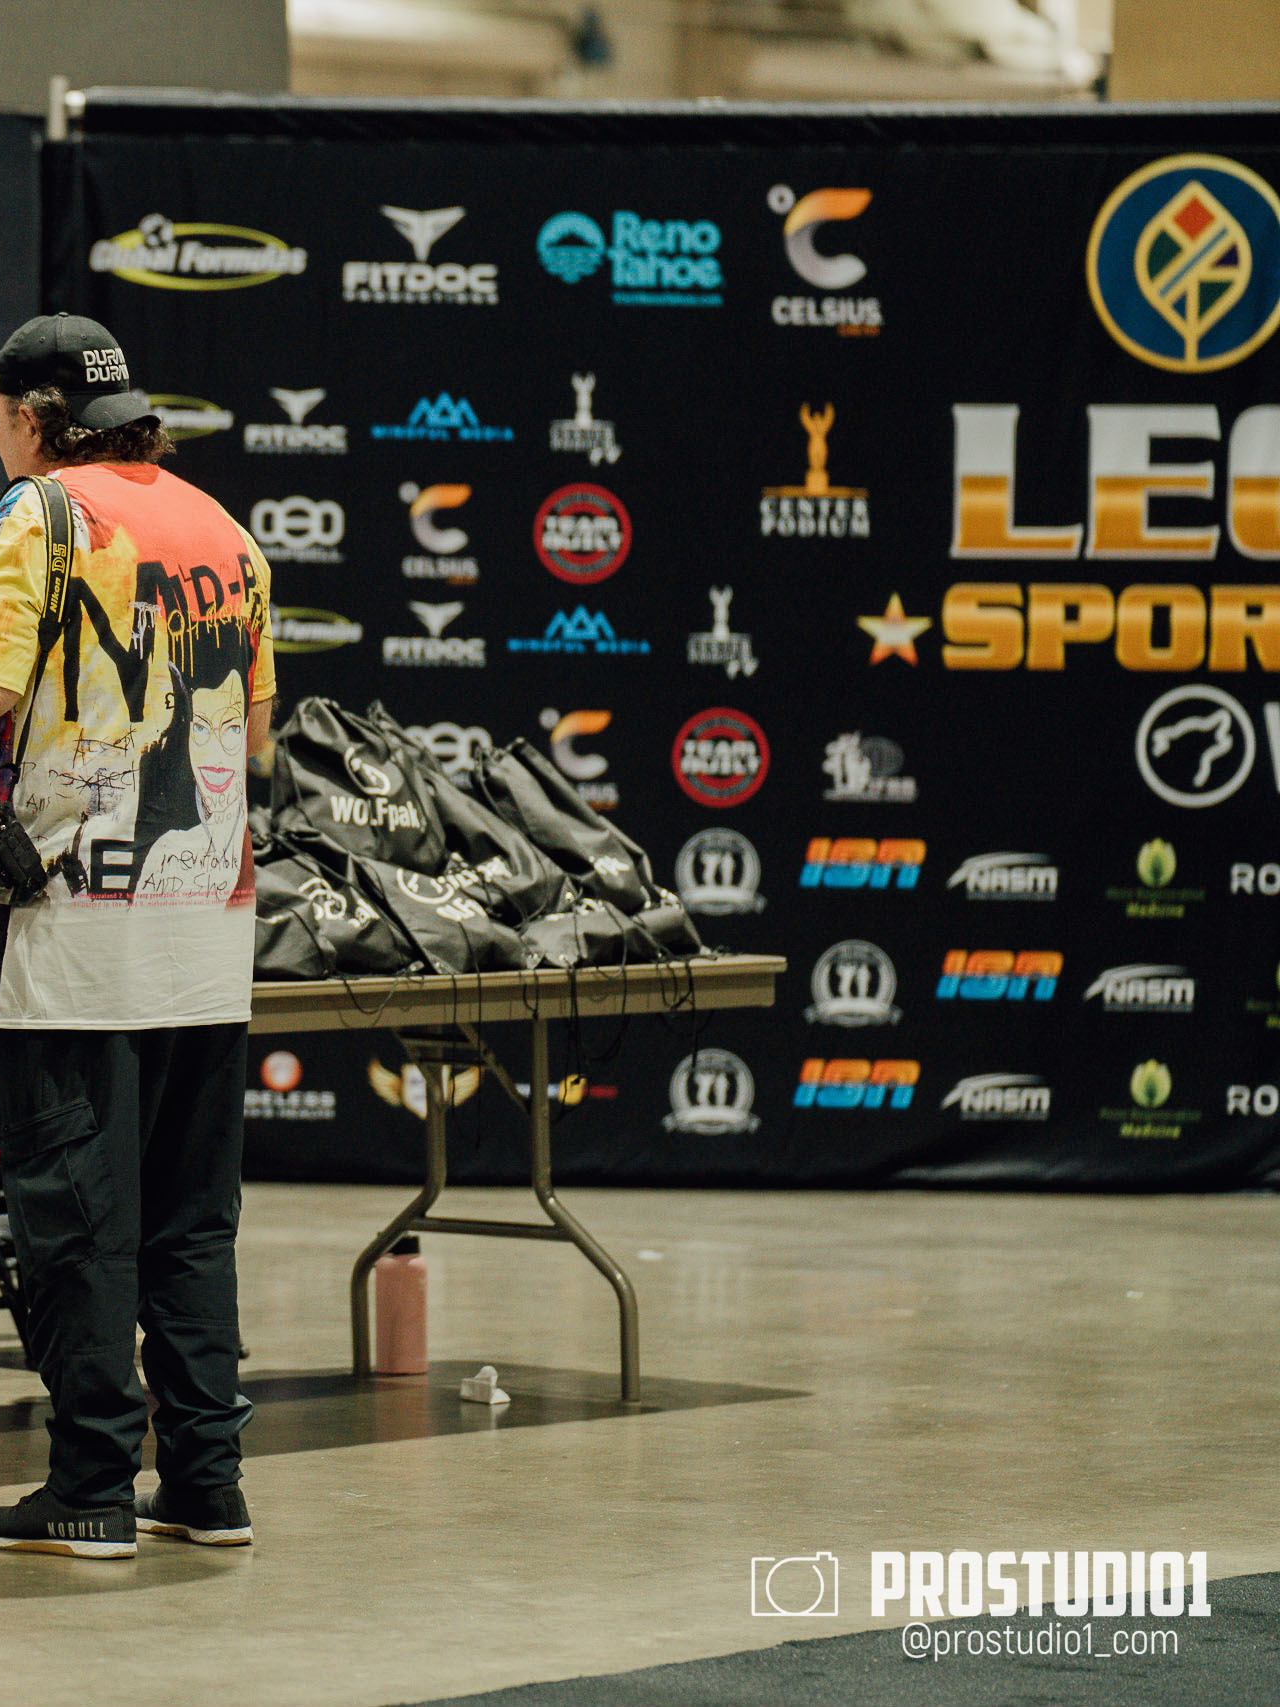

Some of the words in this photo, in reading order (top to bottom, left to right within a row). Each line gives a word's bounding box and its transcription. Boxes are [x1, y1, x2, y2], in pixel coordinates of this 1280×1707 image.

[612, 210, 721, 254] Reno
[177, 241, 307, 275] Formulas
[607, 246, 723, 289] Tahoe
[342, 260, 499, 294] FITDOC
[771, 296, 883, 326] CELSIUS
[49, 577, 62, 613] Nikon
[382, 636, 486, 661] FITDOC
[330, 795, 421, 832] WOFpak
[47, 1521, 107, 1539] NOBULL
